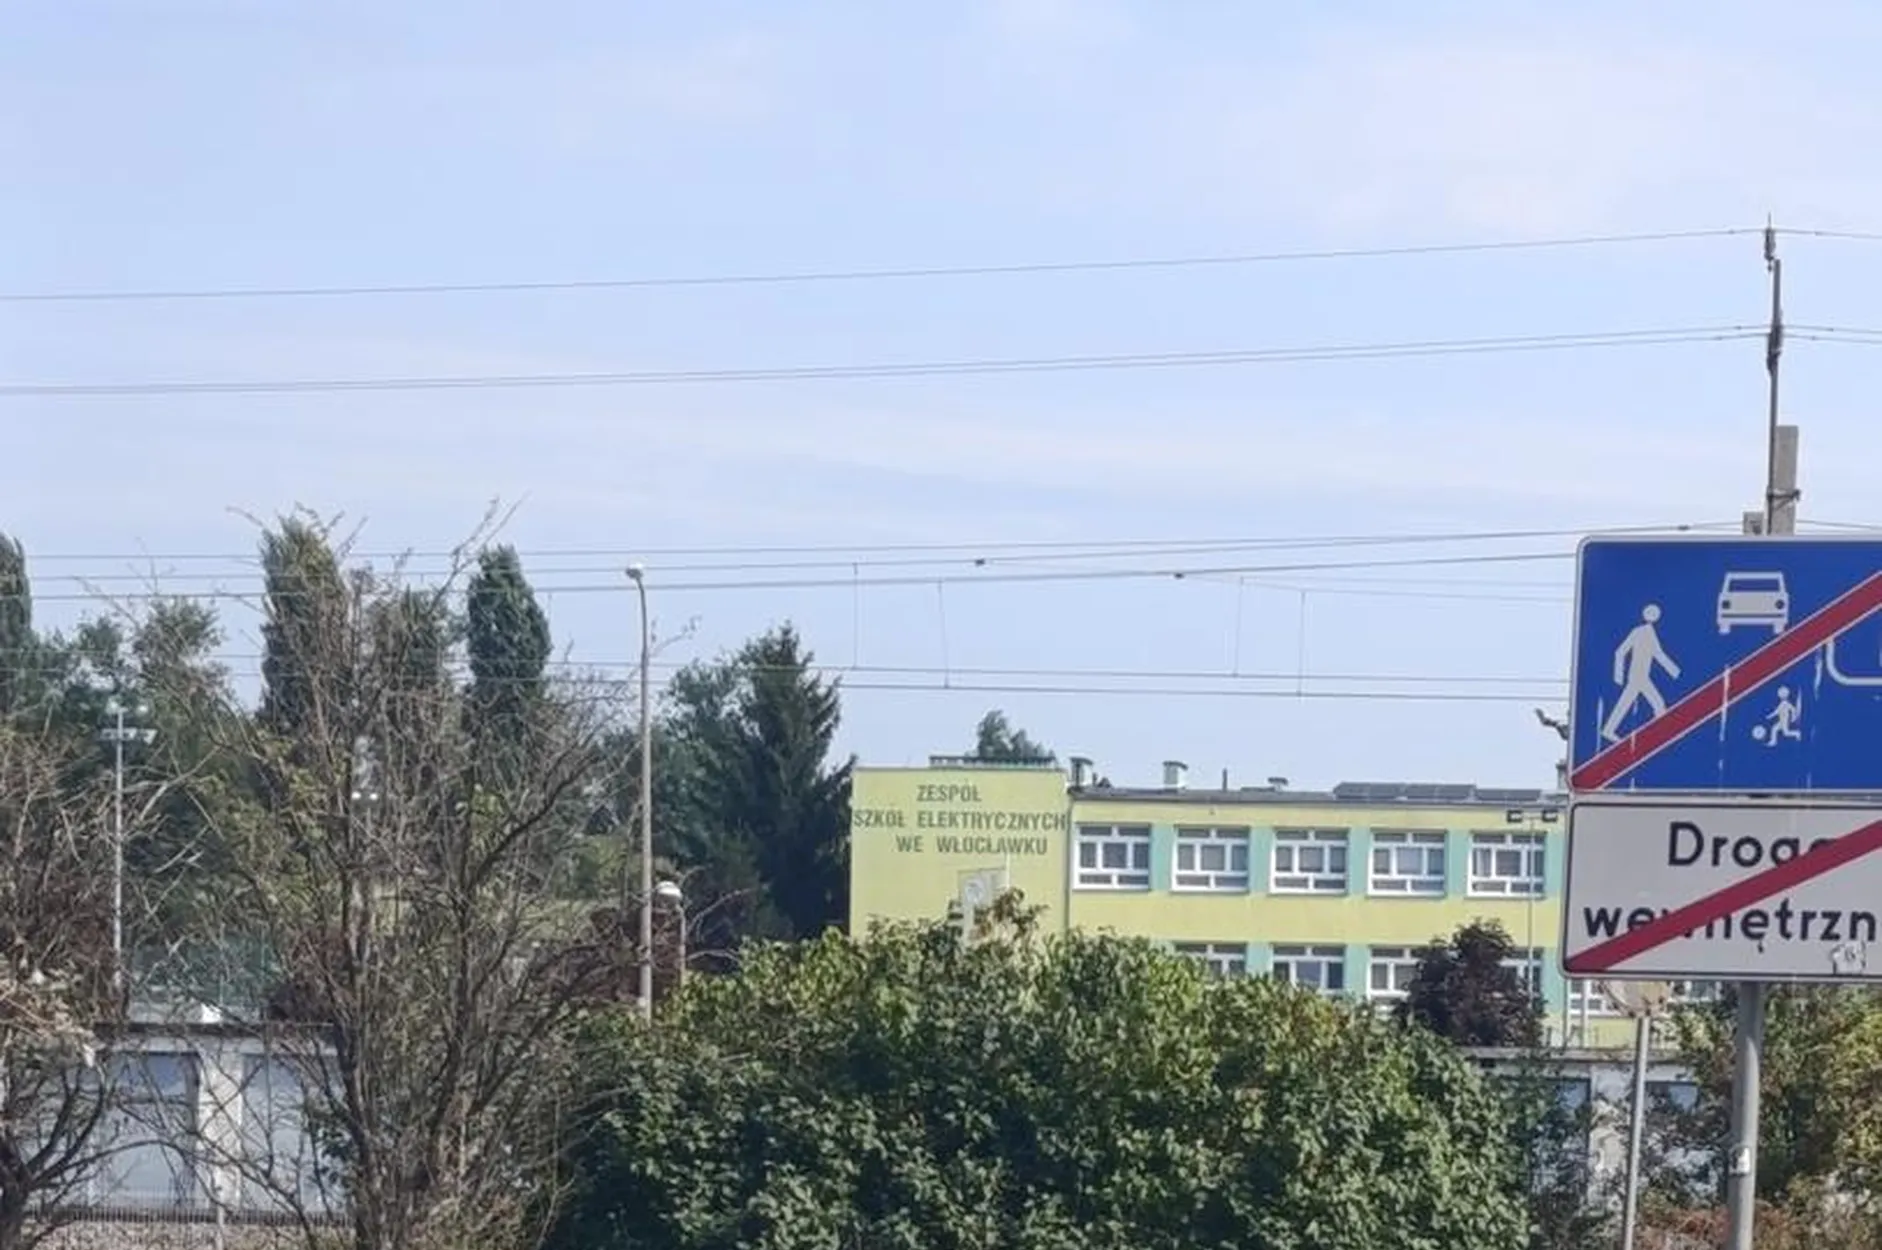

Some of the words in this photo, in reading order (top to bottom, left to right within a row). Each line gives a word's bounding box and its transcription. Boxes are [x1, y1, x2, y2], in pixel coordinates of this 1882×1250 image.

[916, 780, 982, 802] ZESPÓŁ
[854, 806, 906, 829] SZKÓŁ
[917, 810, 1067, 831] ELEKTRYCZNYCH
[896, 834, 924, 853] WE
[936, 835, 1048, 856] WŁOCŁAWKU
